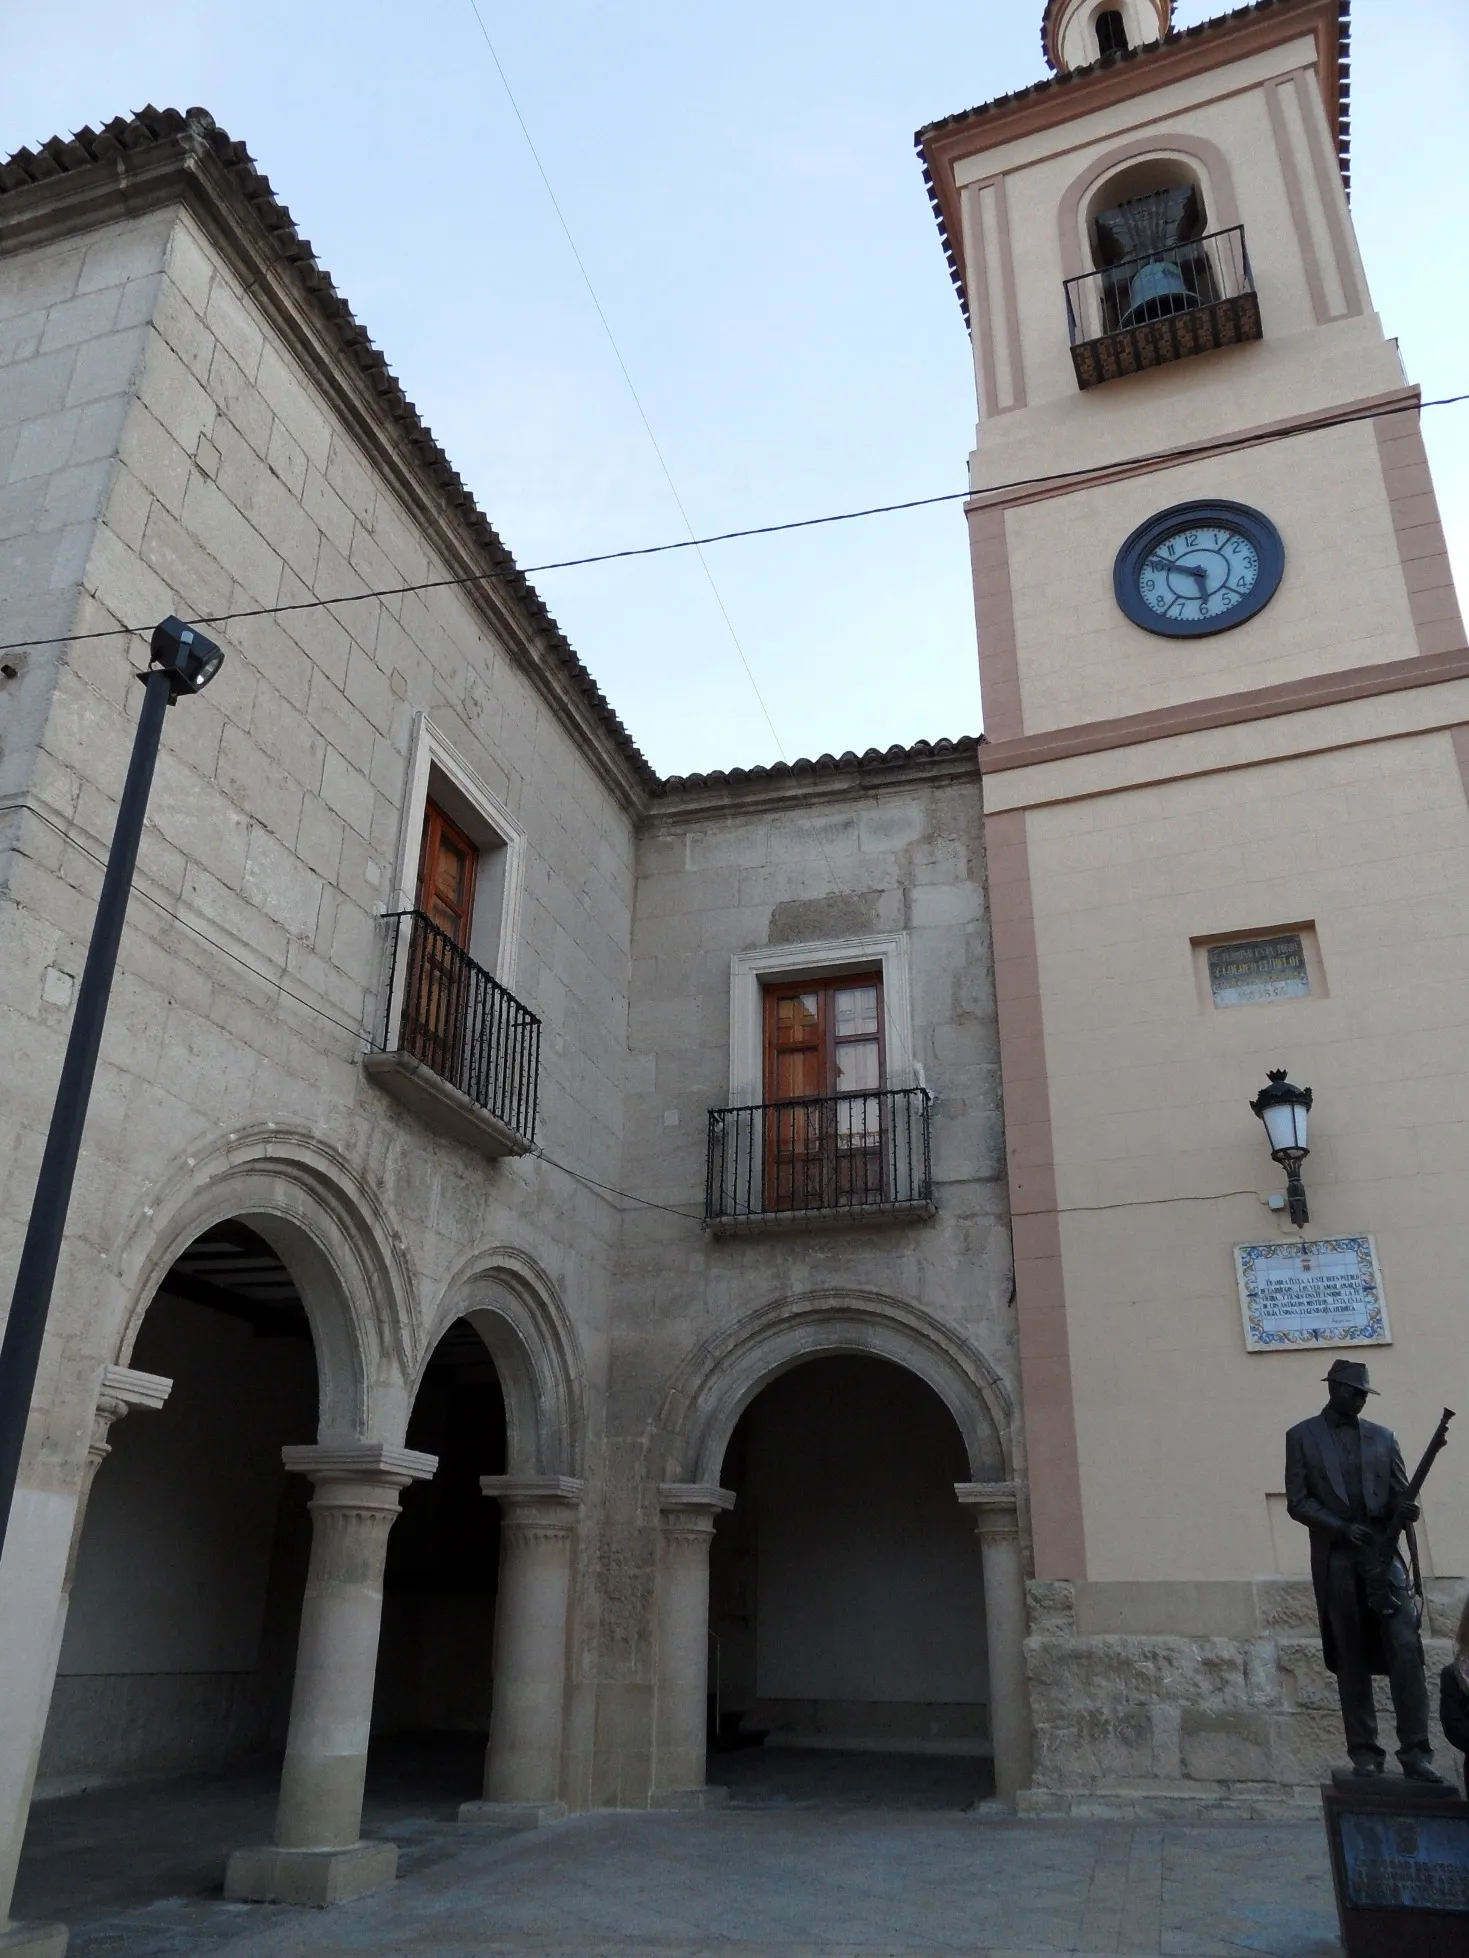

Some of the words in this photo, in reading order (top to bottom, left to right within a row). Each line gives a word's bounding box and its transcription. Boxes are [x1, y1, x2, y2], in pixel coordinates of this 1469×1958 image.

[1184, 533, 1200, 547] 12
[1213, 533, 1219, 545] 1
[1167, 545, 1176, 556] 11
[1231, 541, 1242, 554] 2
[1150, 560, 1165, 573] 10
[1243, 556, 1253, 570] 3
[1146, 579, 1156, 592] 9
[1236, 575, 1248, 590] 4
[1156, 595, 1165, 608] 8
[1221, 592, 1232, 606] 5
[1177, 603, 1186, 617] 7
[1199, 602, 1209, 615] 6
